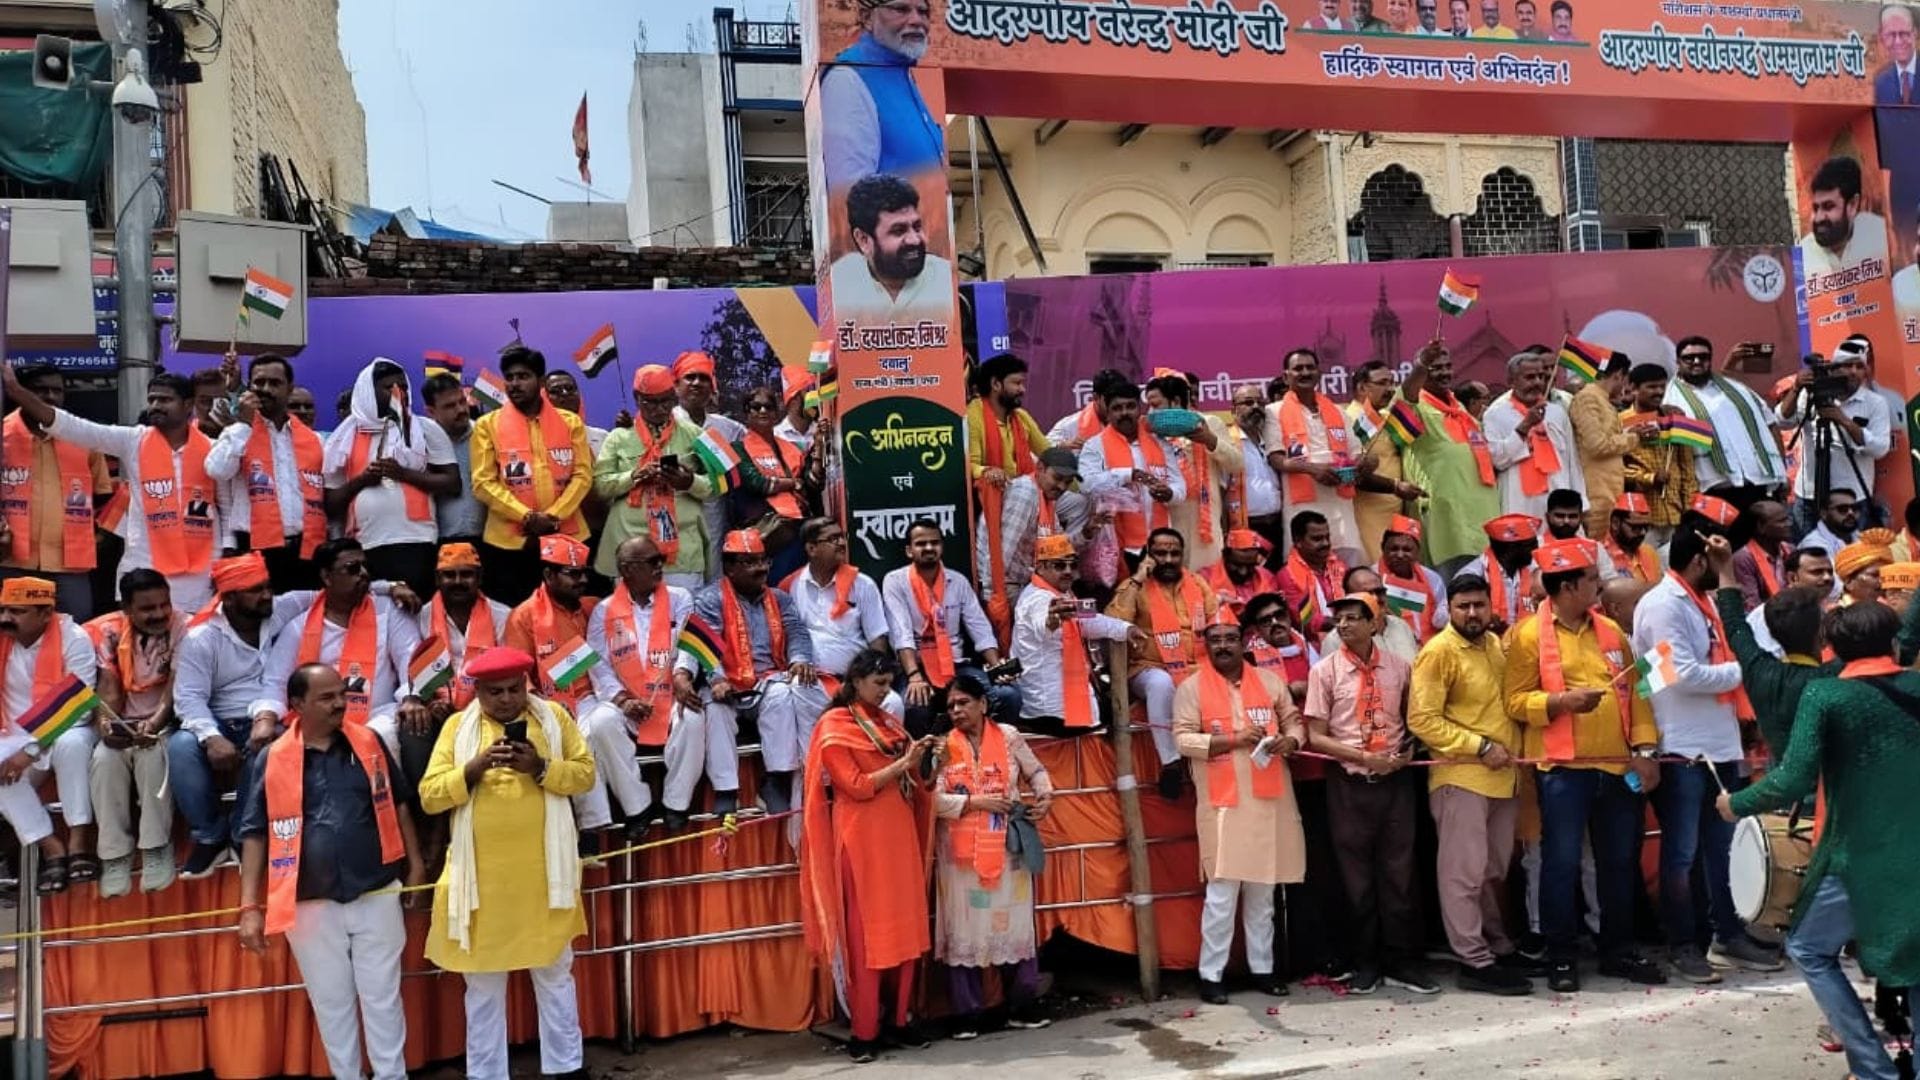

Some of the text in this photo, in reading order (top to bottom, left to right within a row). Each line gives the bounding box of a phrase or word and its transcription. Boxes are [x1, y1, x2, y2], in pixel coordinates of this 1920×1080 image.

[946, 0, 1287, 52] आदरणीय नरेन्द्र मोदी जी
[1321, 47, 1379, 78] हार्दिक
[1383, 55, 1444, 79] स्वागत
[1448, 55, 1476, 82] एवं
[1600, 22, 1684, 72] आदरणीय
[1841, 31, 1866, 77] जी
[838, 320, 947, 351] डॉ. दयाशंकर मिश्र
[891, 472, 915, 491] एवं
